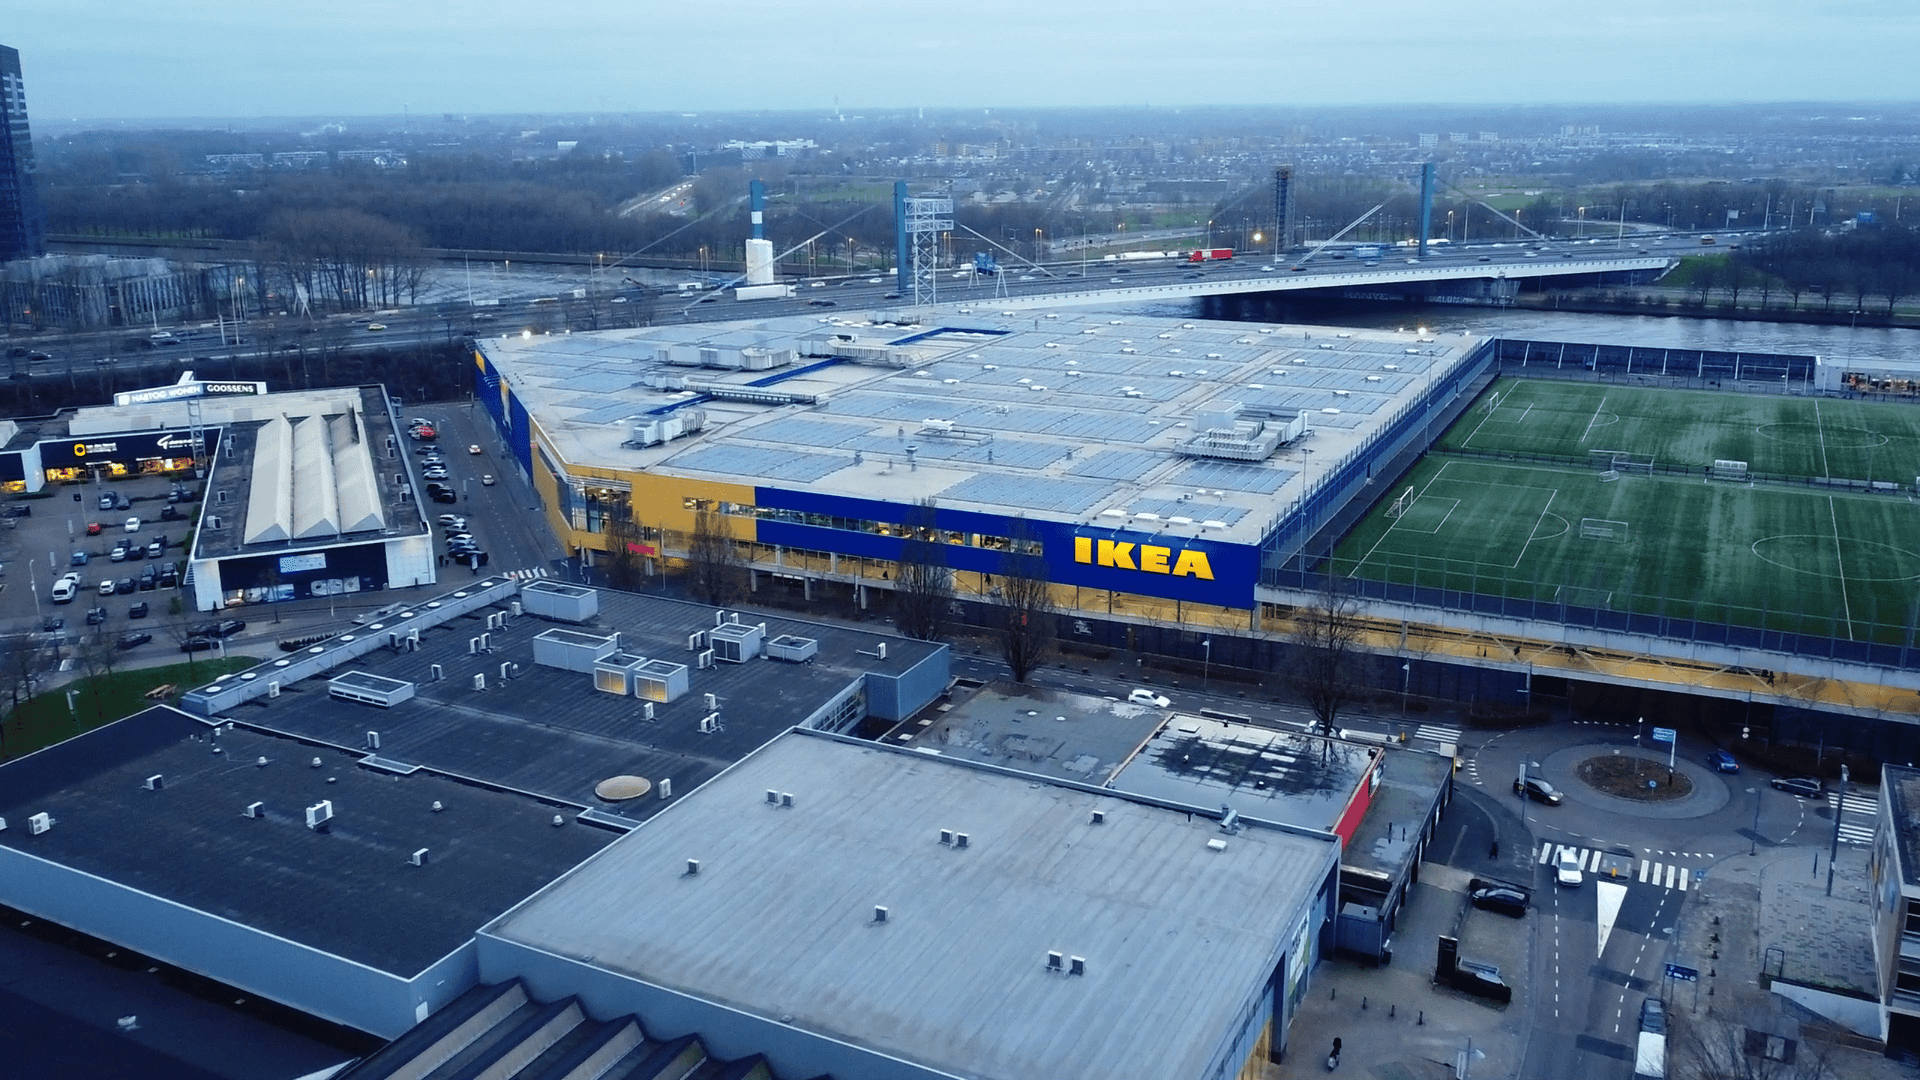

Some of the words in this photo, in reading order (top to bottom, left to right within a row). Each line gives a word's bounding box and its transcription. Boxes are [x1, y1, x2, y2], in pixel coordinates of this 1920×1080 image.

[168, 386, 200, 396] WONEN
[207, 384, 254, 393] GOOSSENS
[1074, 536, 1215, 581] IKEA
